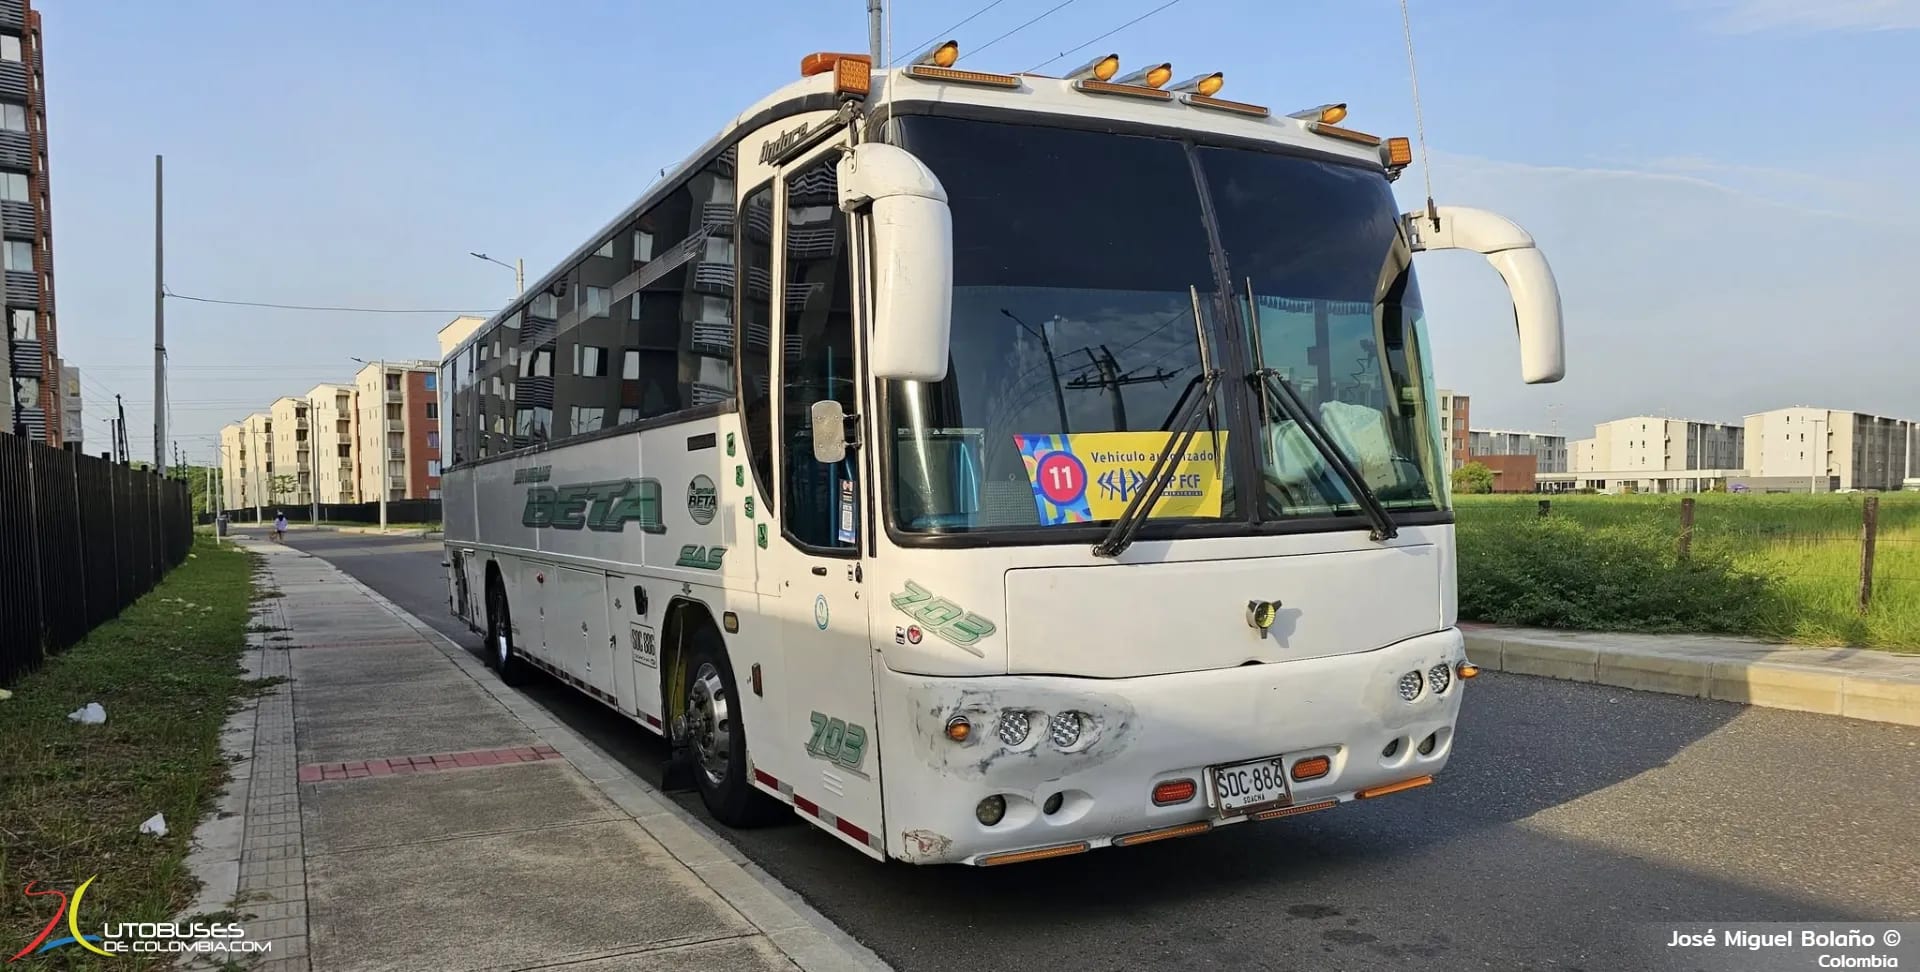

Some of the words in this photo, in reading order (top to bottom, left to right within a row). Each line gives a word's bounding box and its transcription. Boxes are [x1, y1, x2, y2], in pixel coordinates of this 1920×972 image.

[1049, 466, 1074, 490] 11
[1180, 474, 1201, 489] FCF
[522, 477, 667, 534] BETA
[688, 495, 717, 509] BETA
[675, 544, 728, 570] SAS
[890, 578, 996, 648] 703
[806, 711, 869, 770] 703
